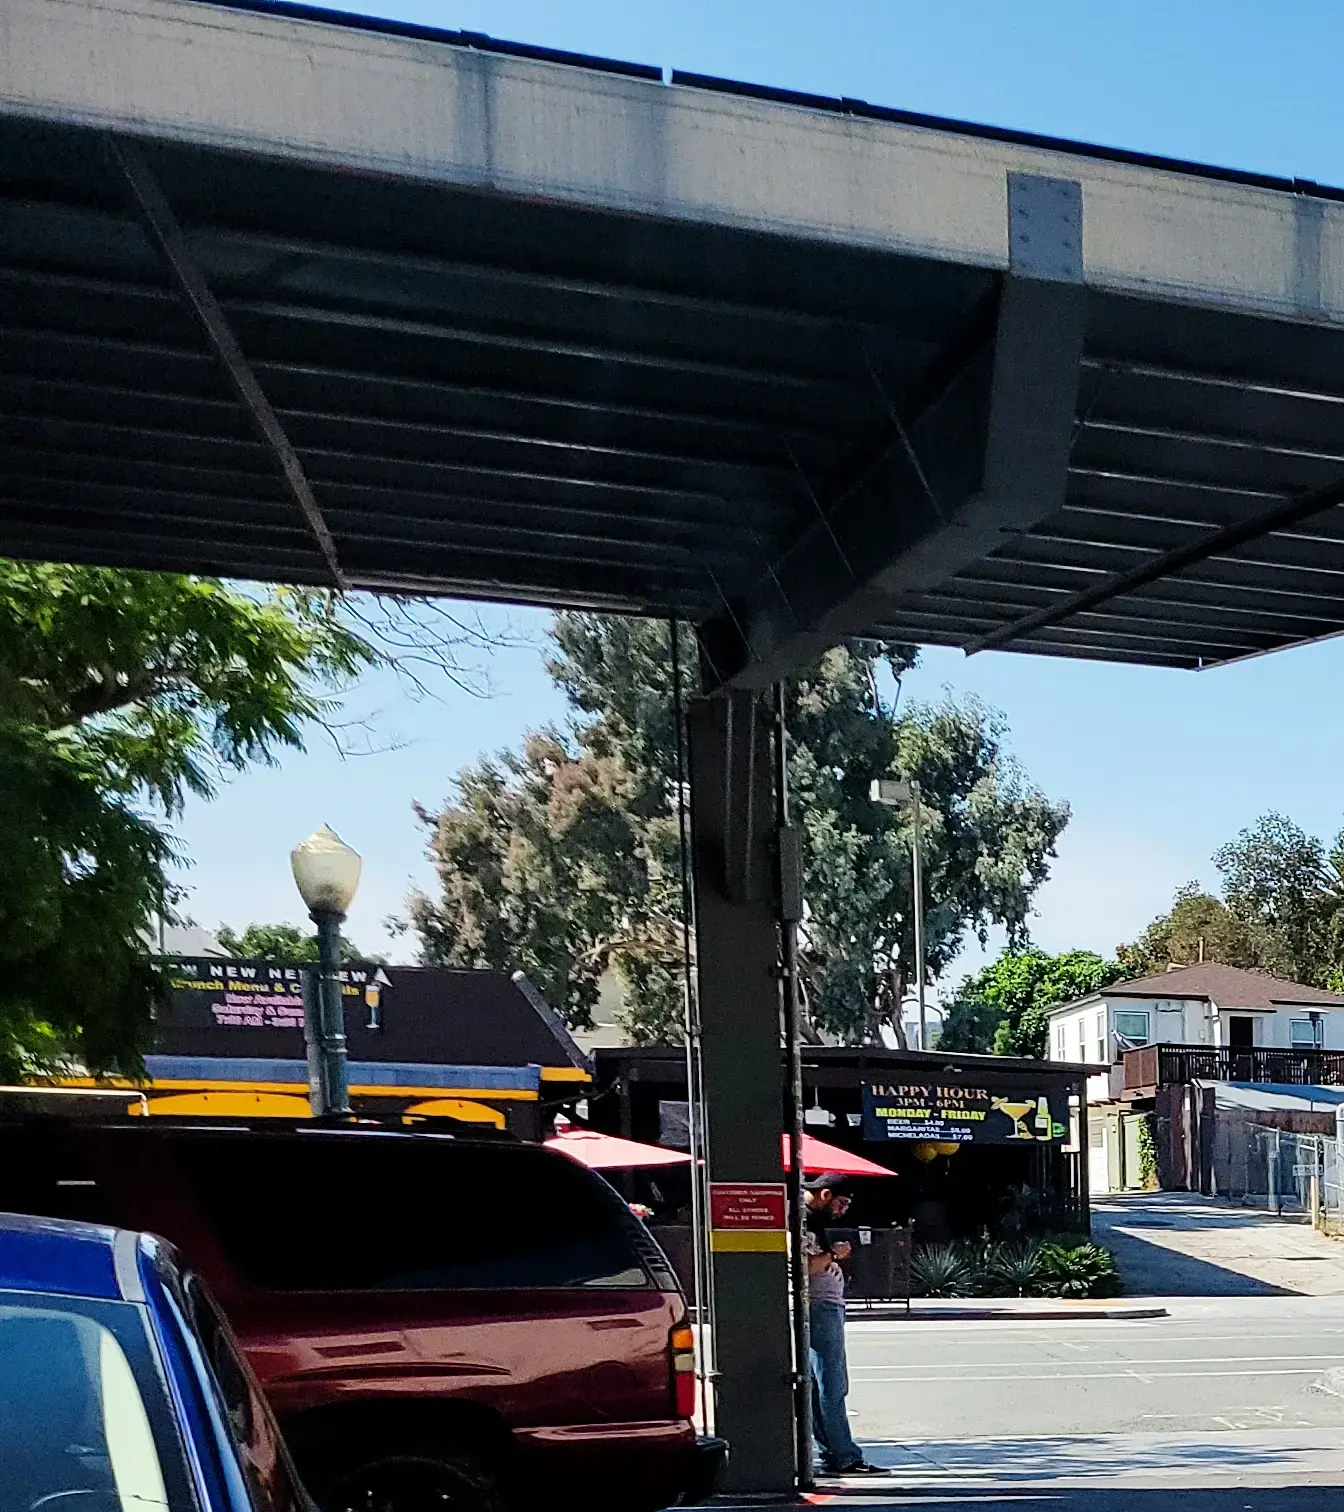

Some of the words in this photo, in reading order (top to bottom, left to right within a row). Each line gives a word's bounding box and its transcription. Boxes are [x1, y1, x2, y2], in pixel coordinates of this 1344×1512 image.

[210, 965, 257, 979] NEW
[228, 981, 270, 993] Menu
[274, 983, 286, 994] &
[872, 1085, 932, 1098] HAPPY
[936, 1086, 989, 1100] HOUR
[936, 1100, 965, 1108] 6PM
[875, 1108, 932, 1118] MONDAY
[941, 1110, 986, 1120] FRIDAY
